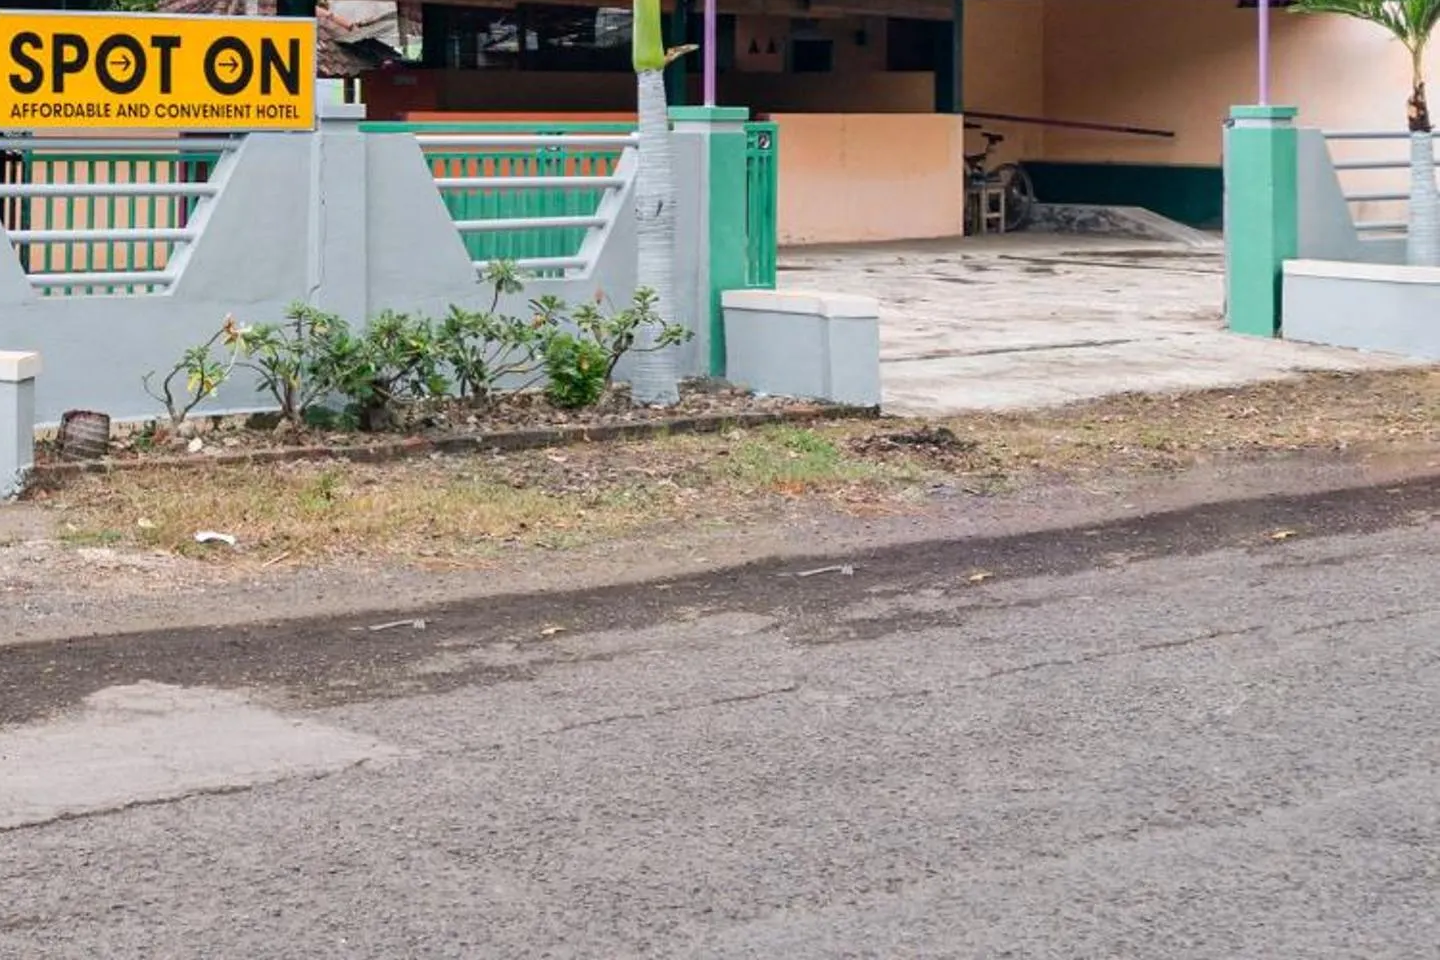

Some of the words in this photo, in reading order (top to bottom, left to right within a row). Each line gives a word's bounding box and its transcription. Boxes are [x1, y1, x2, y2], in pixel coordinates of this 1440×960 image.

[8, 31, 182, 95] SPOT
[203, 35, 301, 96] ON
[11, 102, 111, 118] AFFORDABLE
[116, 103, 151, 118] AND
[154, 103, 251, 119] CONVENIENT
[256, 104, 299, 119] HOTEL
